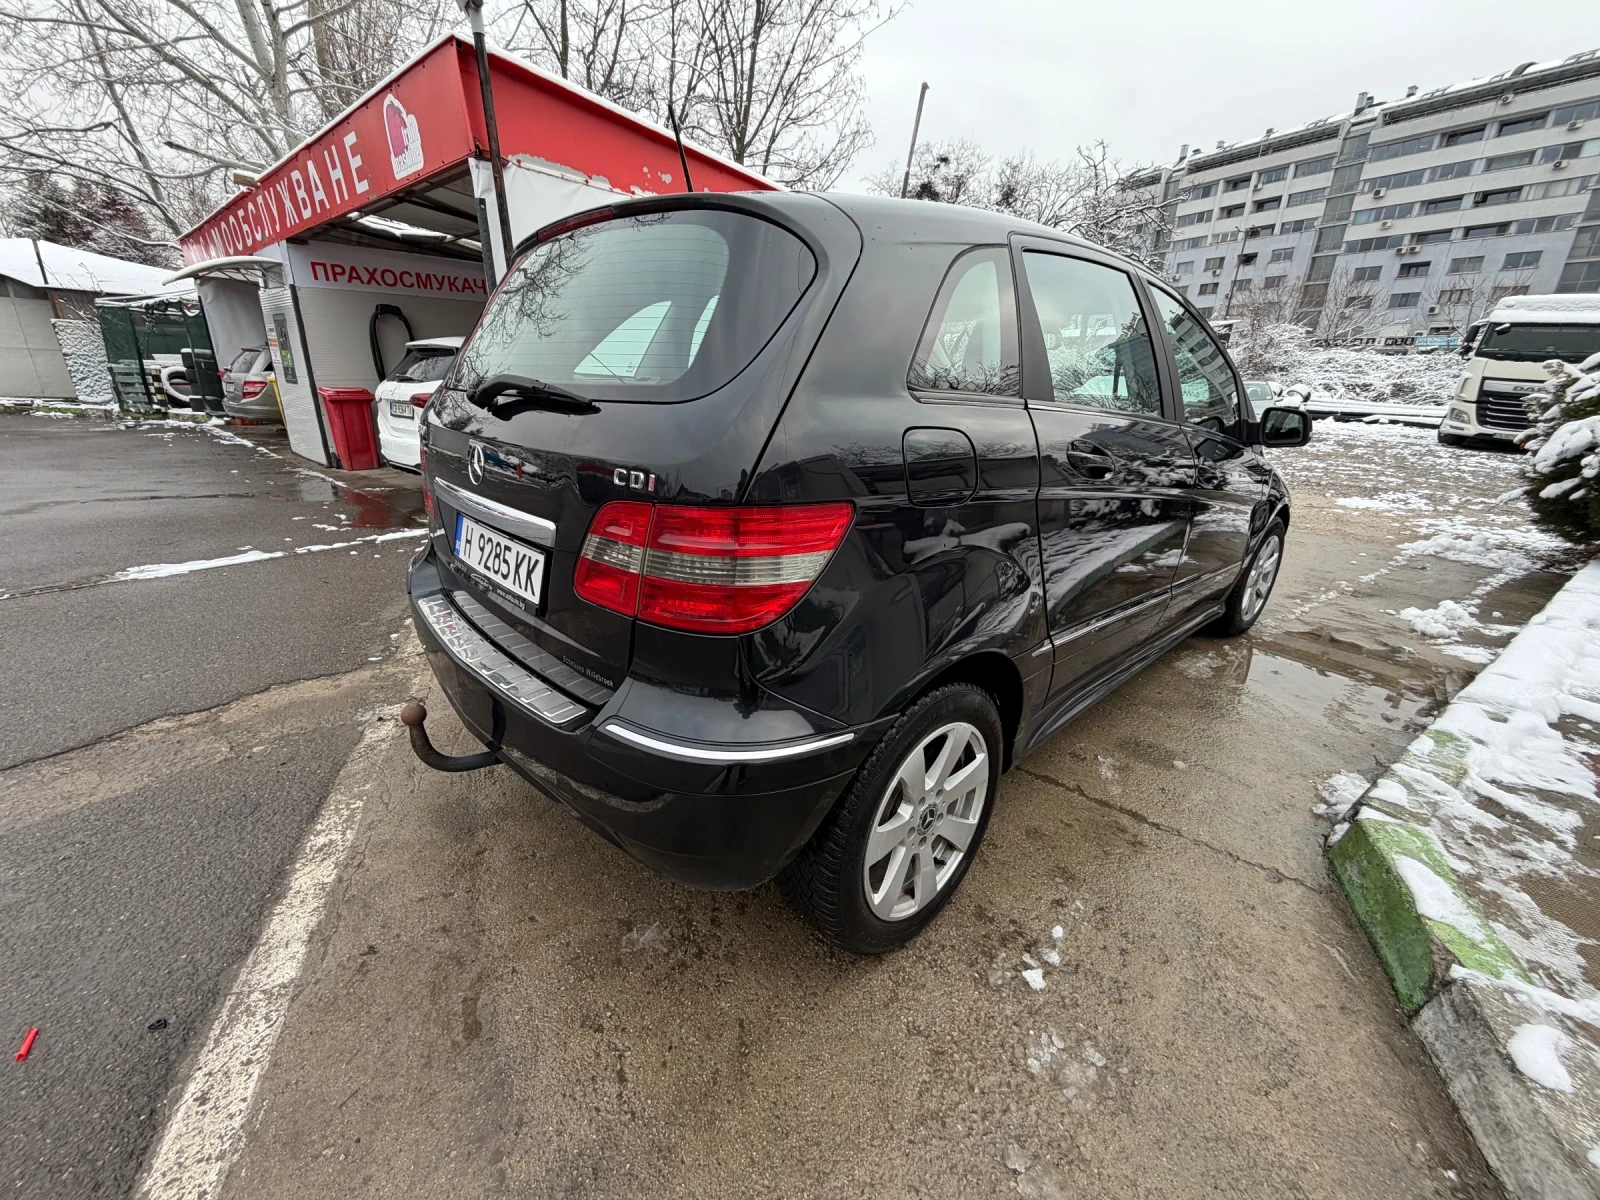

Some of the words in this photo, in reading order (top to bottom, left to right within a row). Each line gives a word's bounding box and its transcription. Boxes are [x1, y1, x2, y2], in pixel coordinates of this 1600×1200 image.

[310, 261, 488, 295] ПРАХОСМУКАЧ
[613, 468, 656, 492] CDI
[463, 524, 474, 560] H
[477, 532, 513, 581] 9285
[513, 550, 541, 597] KK
